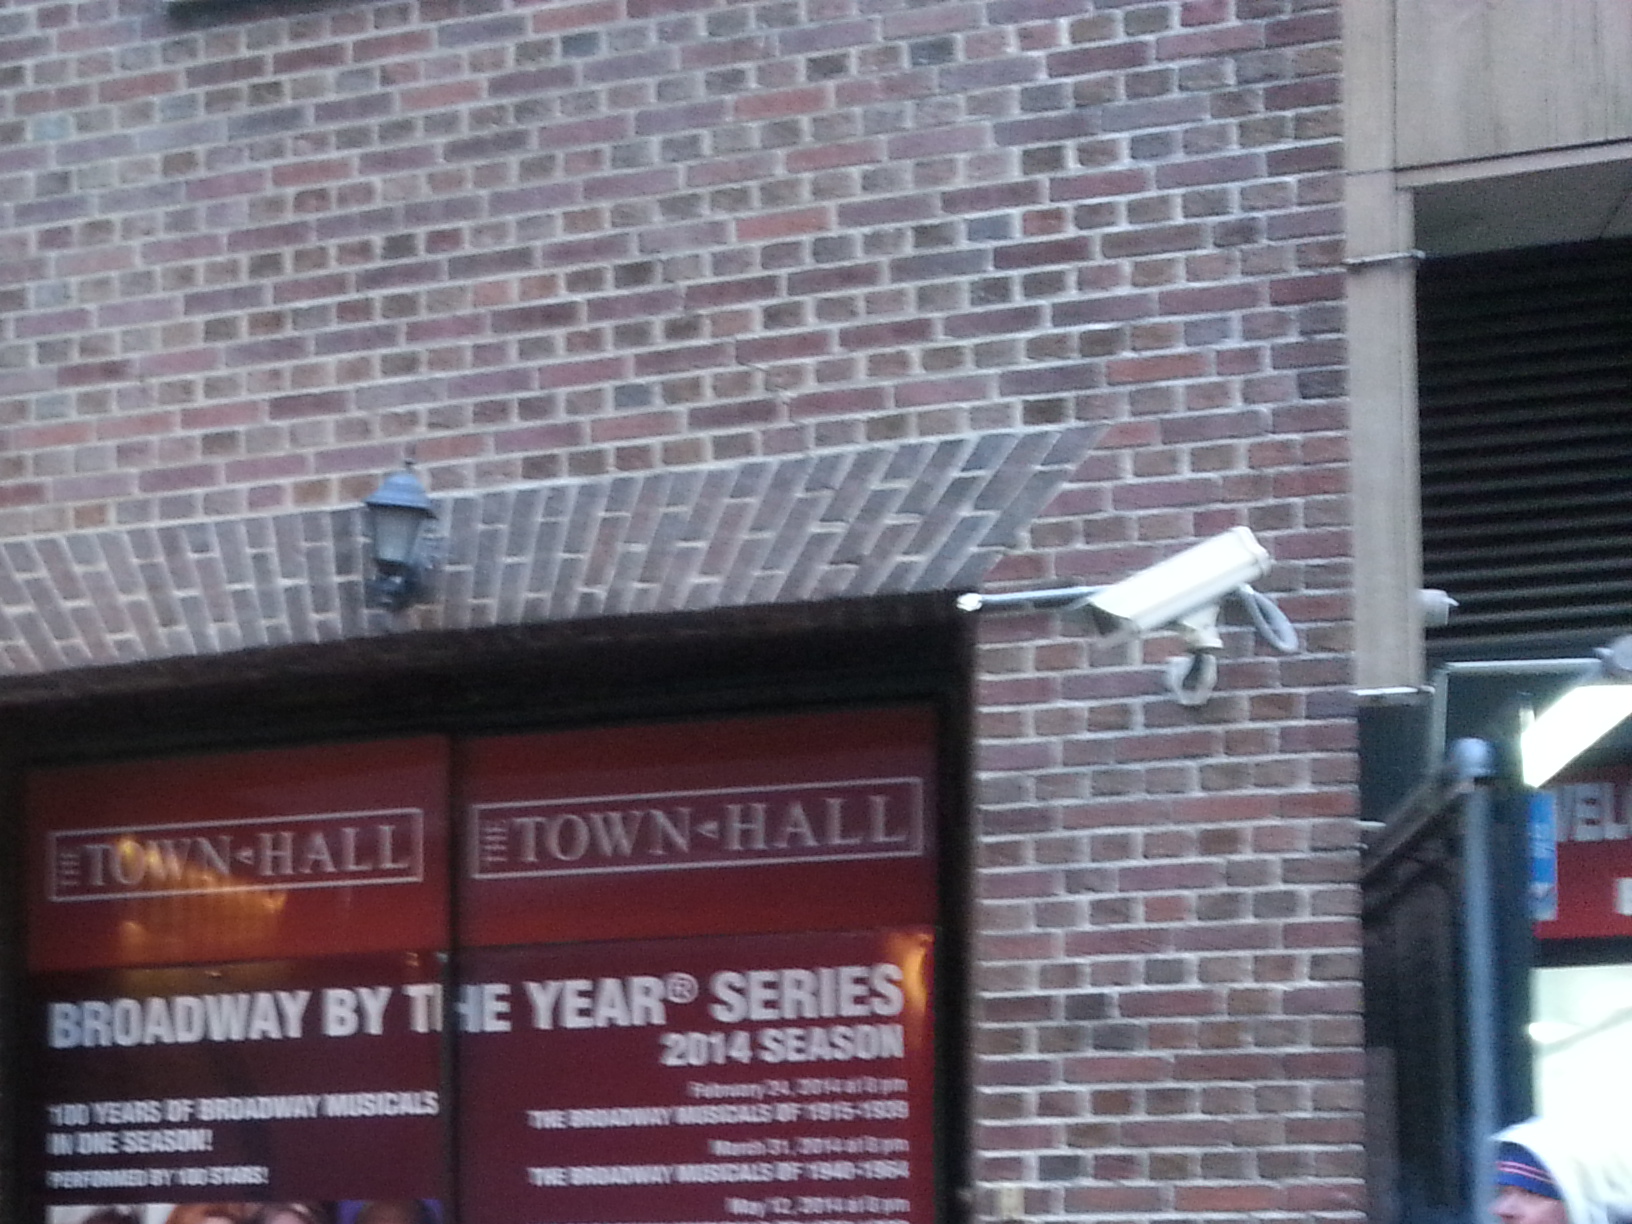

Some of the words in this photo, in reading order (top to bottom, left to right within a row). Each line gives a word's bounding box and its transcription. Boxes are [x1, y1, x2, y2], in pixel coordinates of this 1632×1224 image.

[512, 806, 694, 863] TOWN
[723, 794, 908, 851] HALL
[82, 834, 234, 887] TOWN
[258, 823, 409, 877] HALL
[48, 990, 310, 1049] BROADWAY
[322, 986, 392, 1037] BY
[403, 982, 512, 1034] THE
[709, 964, 904, 1023] SERIES
[660, 1032, 752, 1066] 2014
[757, 1024, 905, 1063] SEASON
[47, 1103, 90, 1126] 100
[92, 1099, 162, 1125] YEARS
[165, 1099, 195, 1121] OF
[197, 1094, 320, 1121] BROADWAY
[324, 1091, 439, 1117] MUSICALS
[567, 1107, 670, 1128] BROADWAY
[674, 1104, 772, 1125] MUSICALS
[773, 1103, 804, 1123] OF
[45, 1133, 76, 1156] IN
[78, 1131, 120, 1154] ONE
[120, 1129, 213, 1153] SEASON!
[567, 1164, 671, 1186] BROADWAY
[674, 1162, 773, 1183] MUSICALS
